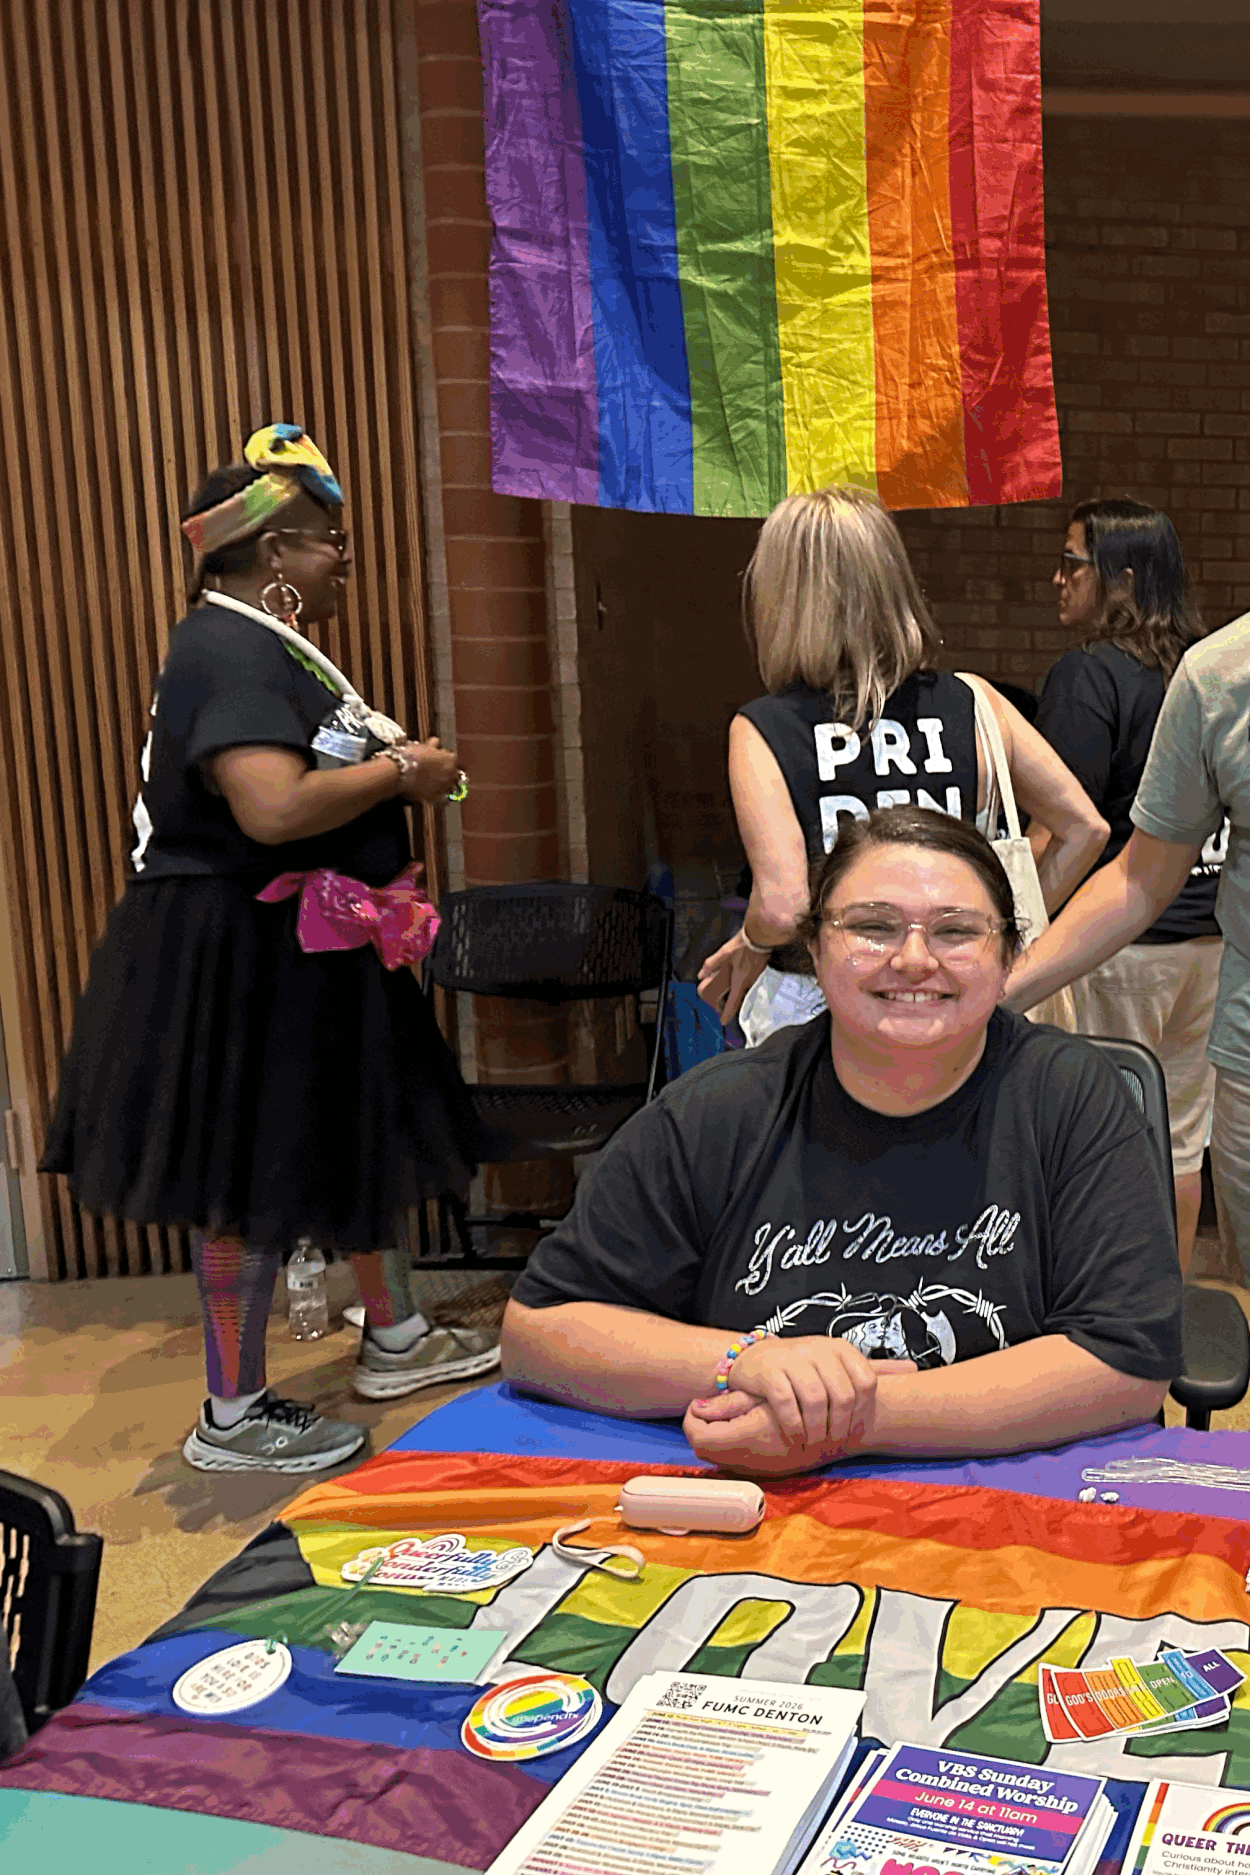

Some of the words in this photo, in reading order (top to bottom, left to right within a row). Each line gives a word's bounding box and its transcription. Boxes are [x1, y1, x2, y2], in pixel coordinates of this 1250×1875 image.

[814, 718, 952, 781] PRI
[735, 1219, 837, 1295] Y'all
[843, 1212, 949, 1263] Means
[948, 1204, 1020, 1269] All
[376, 1561, 496, 1582] onderfully
[1065, 1692, 1092, 1706] GOD'S
[1095, 1687, 1125, 1700] DOORS
[1150, 1677, 1175, 1688] OPEN
[1202, 1662, 1220, 1672] ALL
[701, 1700, 747, 1715] FUMC
[753, 1707, 823, 1726] DENTON
[733, 1695, 776, 1709] SUMMER
[779, 1701, 804, 1711] 2026
[938, 1760, 977, 1778] VBS
[978, 1764, 1054, 1794] Sunday
[895, 1768, 995, 1798] Combined
[996, 1786, 1078, 1815] Worship
[910, 1809, 948, 1823] EVERYONE
[950, 1815, 958, 1824] IN
[961, 1817, 975, 1828] THE
[915, 1791, 954, 1808] June
[958, 1799, 975, 1811] 14
[977, 1804, 996, 1816] at
[999, 1806, 1037, 1824] 11am
[1161, 1832, 1217, 1851] QUEER
[1161, 1850, 1202, 1863] Curious
[1204, 1856, 1238, 1867] about
[1163, 1860, 1223, 1875] Christianity
